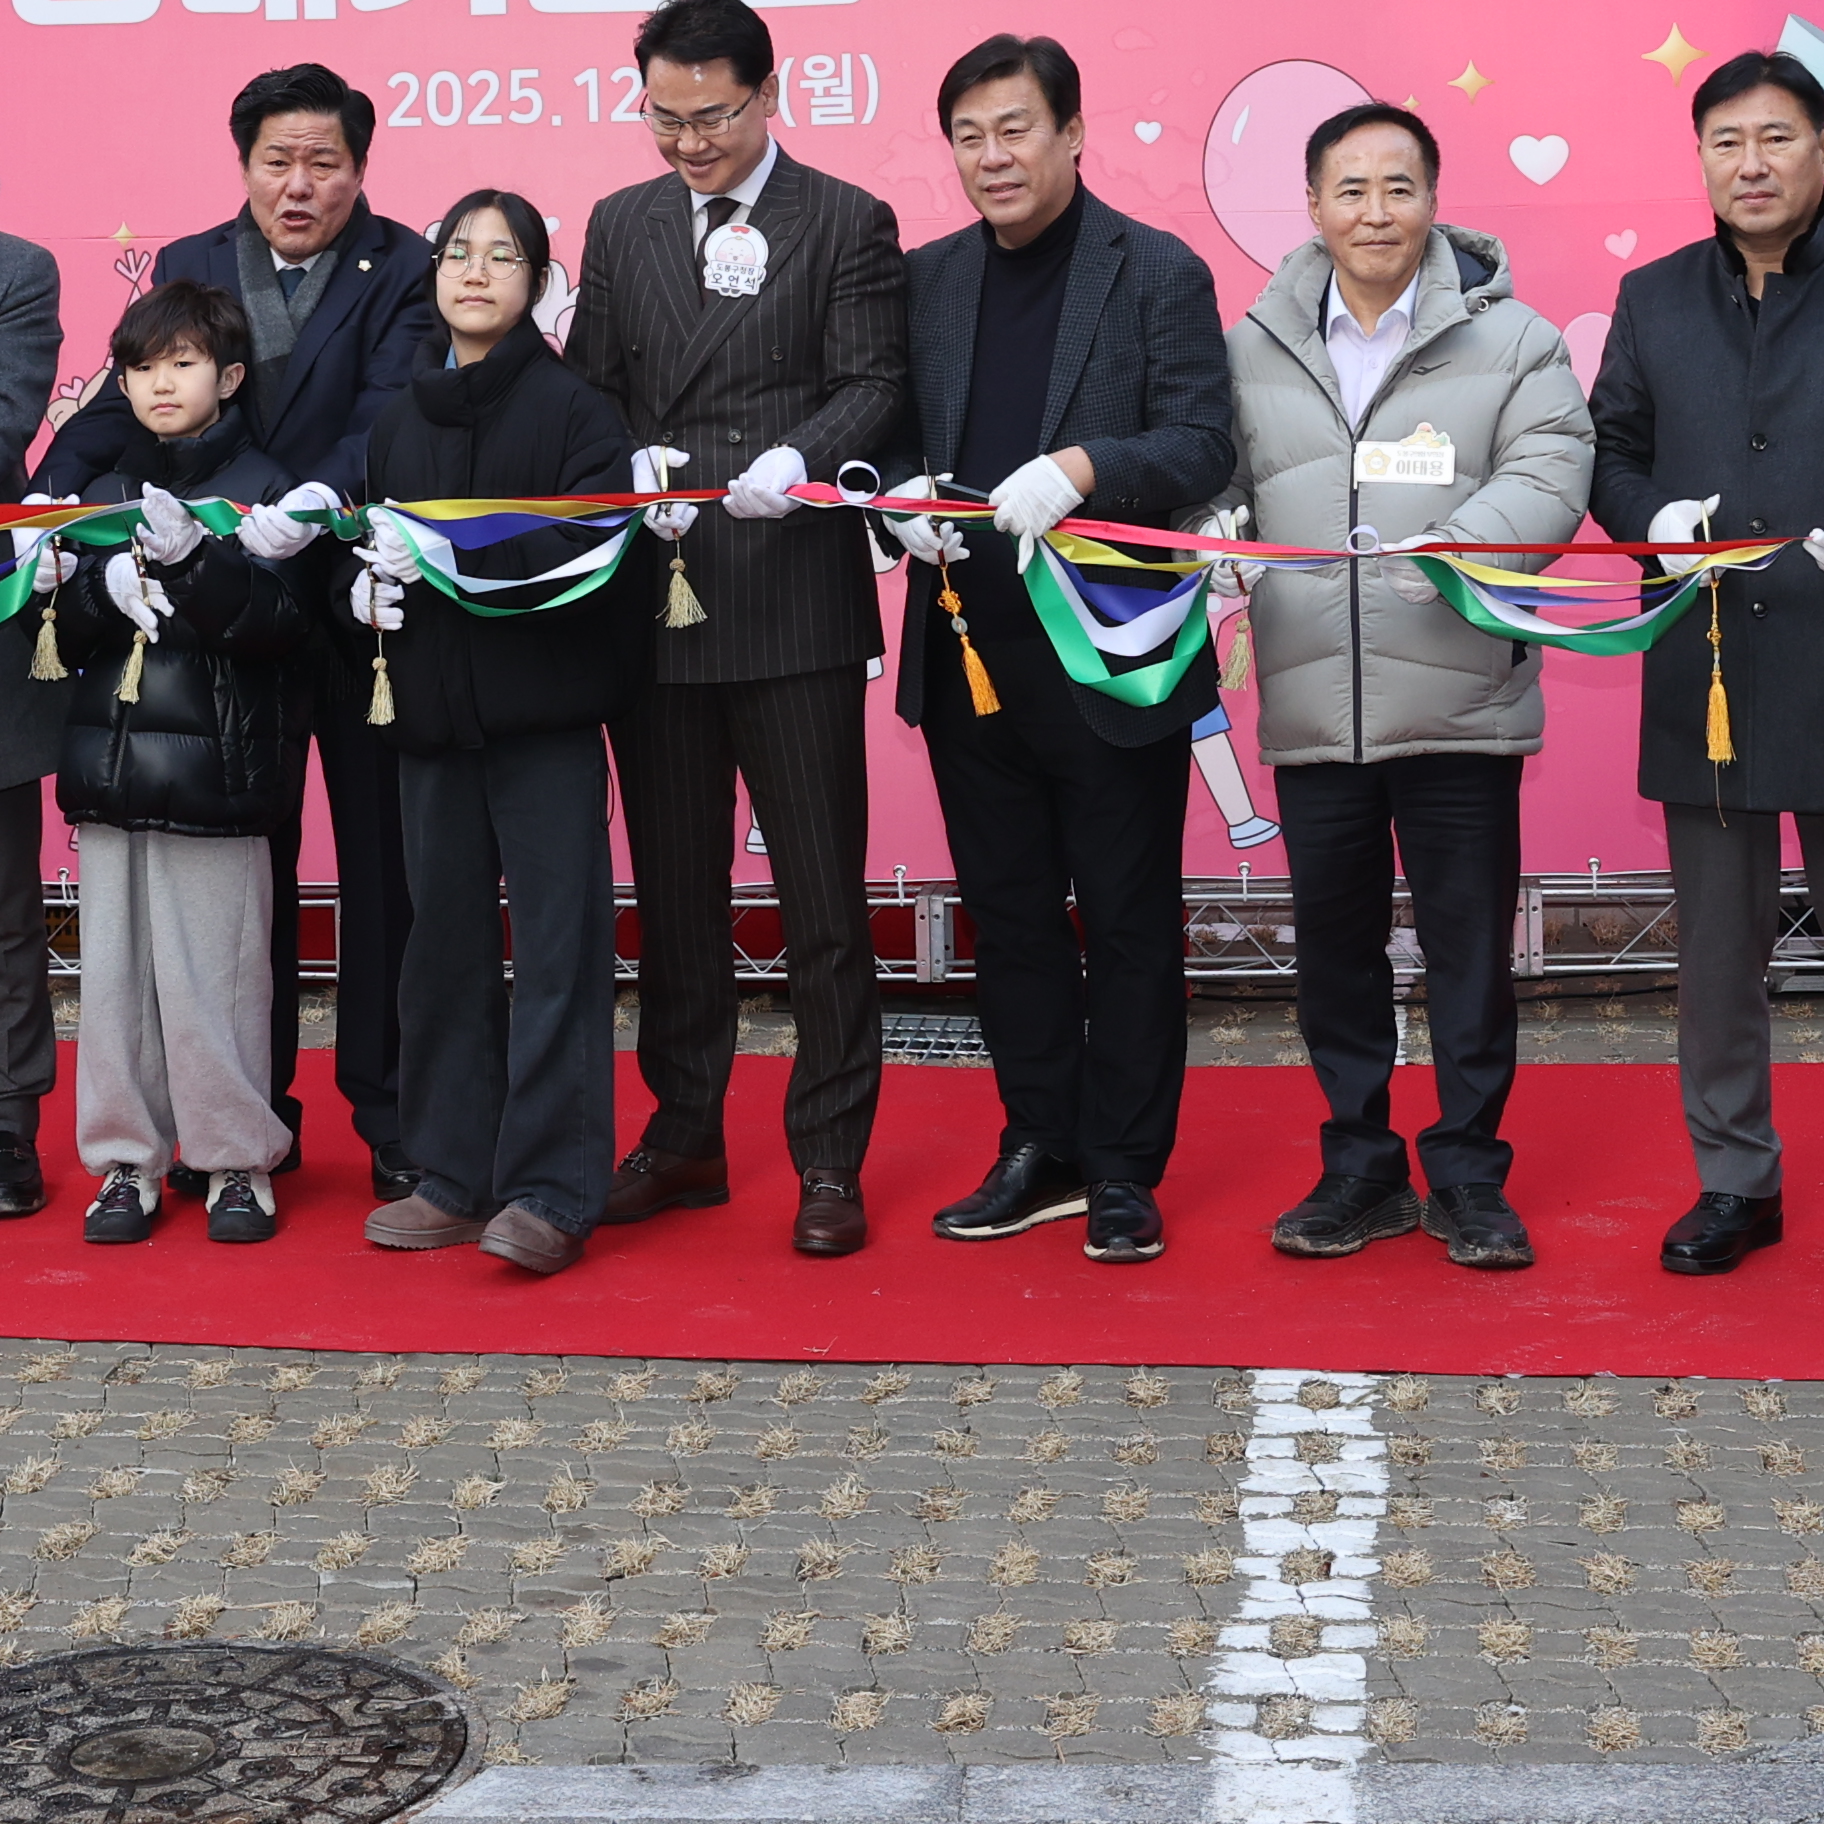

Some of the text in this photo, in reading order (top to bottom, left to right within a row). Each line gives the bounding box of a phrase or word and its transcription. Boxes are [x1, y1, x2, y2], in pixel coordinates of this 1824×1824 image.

[716, 263, 755, 275] 도봉구청장
[711, 273, 756, 290] 오언석
[1395, 459, 1445, 477] 이태용
